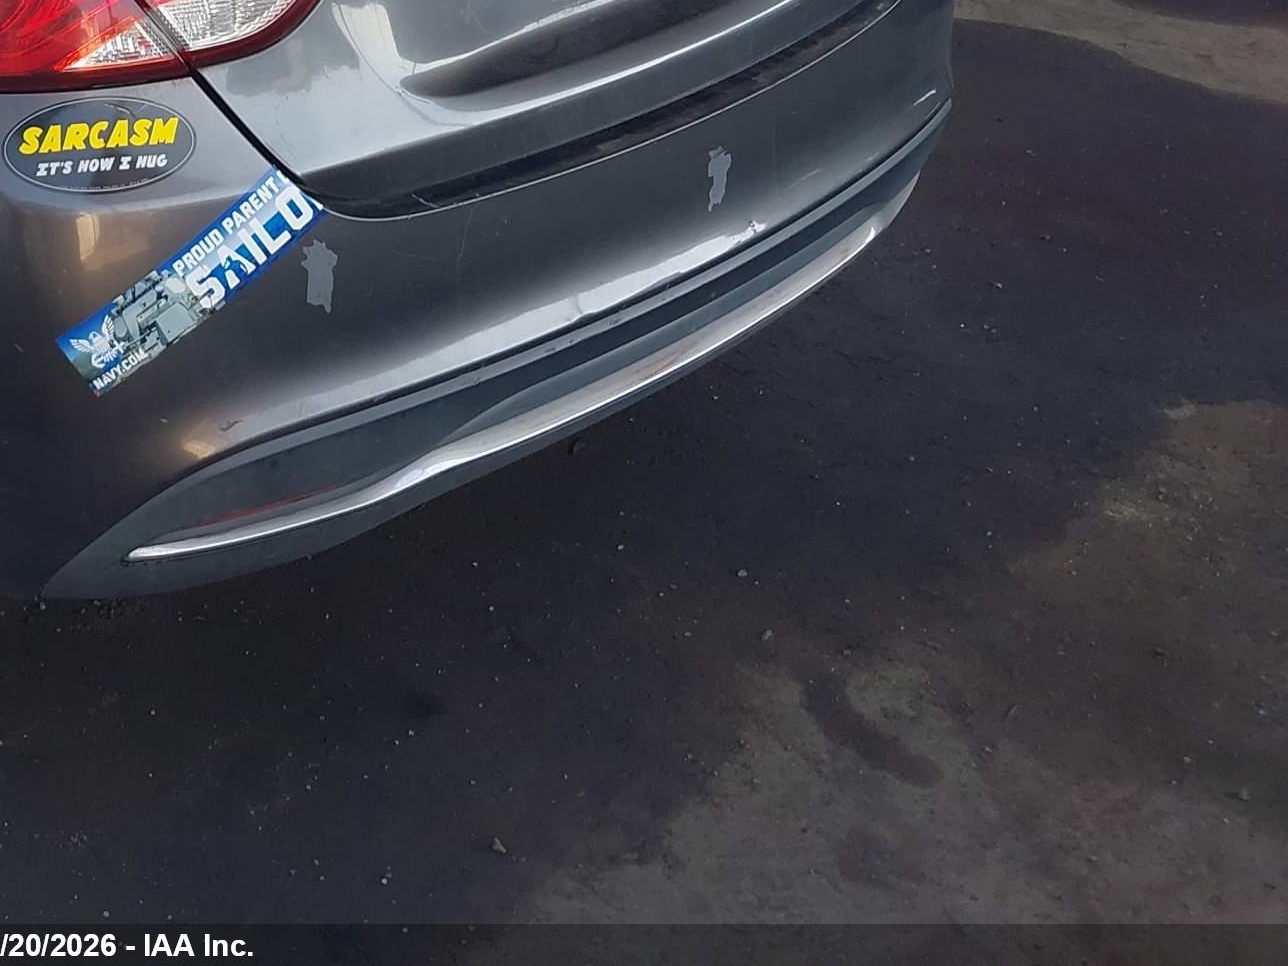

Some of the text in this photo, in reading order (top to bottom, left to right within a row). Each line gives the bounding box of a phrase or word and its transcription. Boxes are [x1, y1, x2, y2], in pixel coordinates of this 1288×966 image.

[19, 117, 179, 155] SARCASM
[36, 154, 168, 176] IT'S HOW I HUG
[172, 176, 280, 277] PROUD PARENT
[186, 186, 323, 308] SAILO
[92, 347, 150, 390] NAVY.COM
